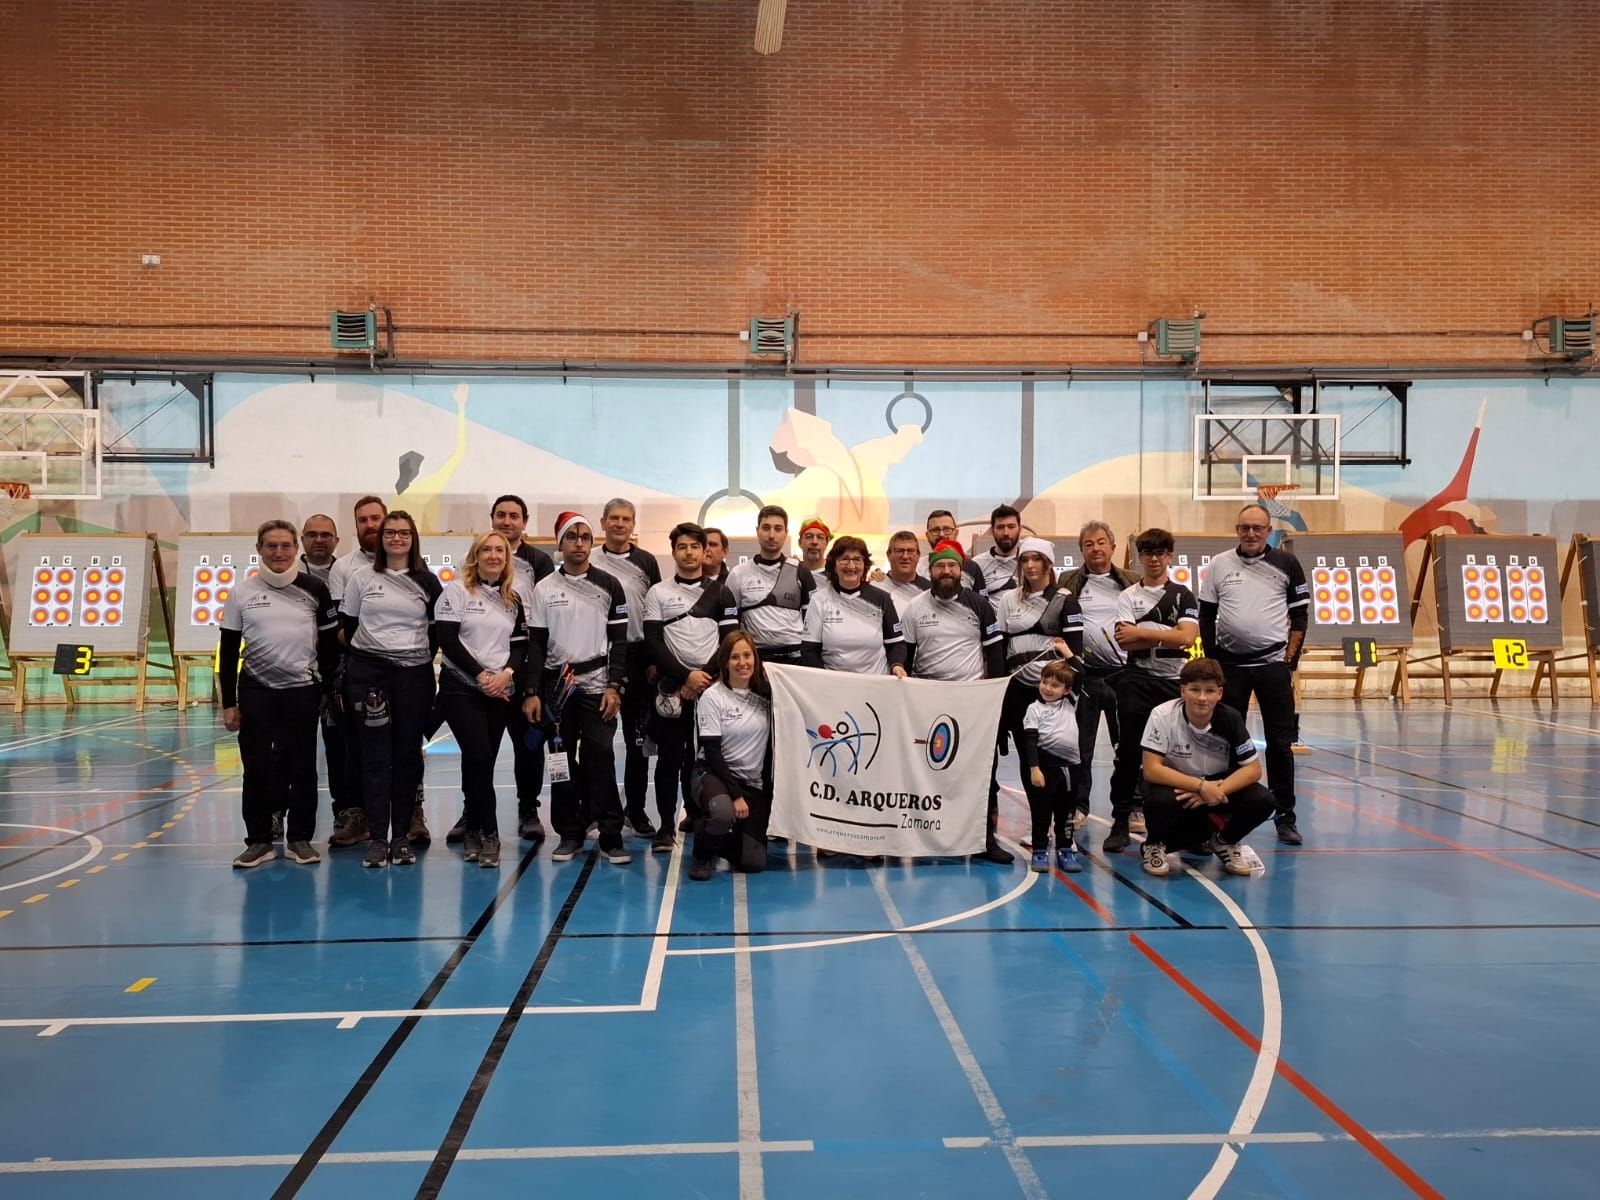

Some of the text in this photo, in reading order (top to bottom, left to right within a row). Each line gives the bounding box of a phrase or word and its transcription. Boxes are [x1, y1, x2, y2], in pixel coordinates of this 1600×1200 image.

[74, 646, 92, 674] 3
[1354, 641, 1377, 663] 11
[1505, 642, 1525, 667] 12
[809, 781, 943, 812] C.D. ARQUEROS
[901, 813, 942, 831] Zamora
